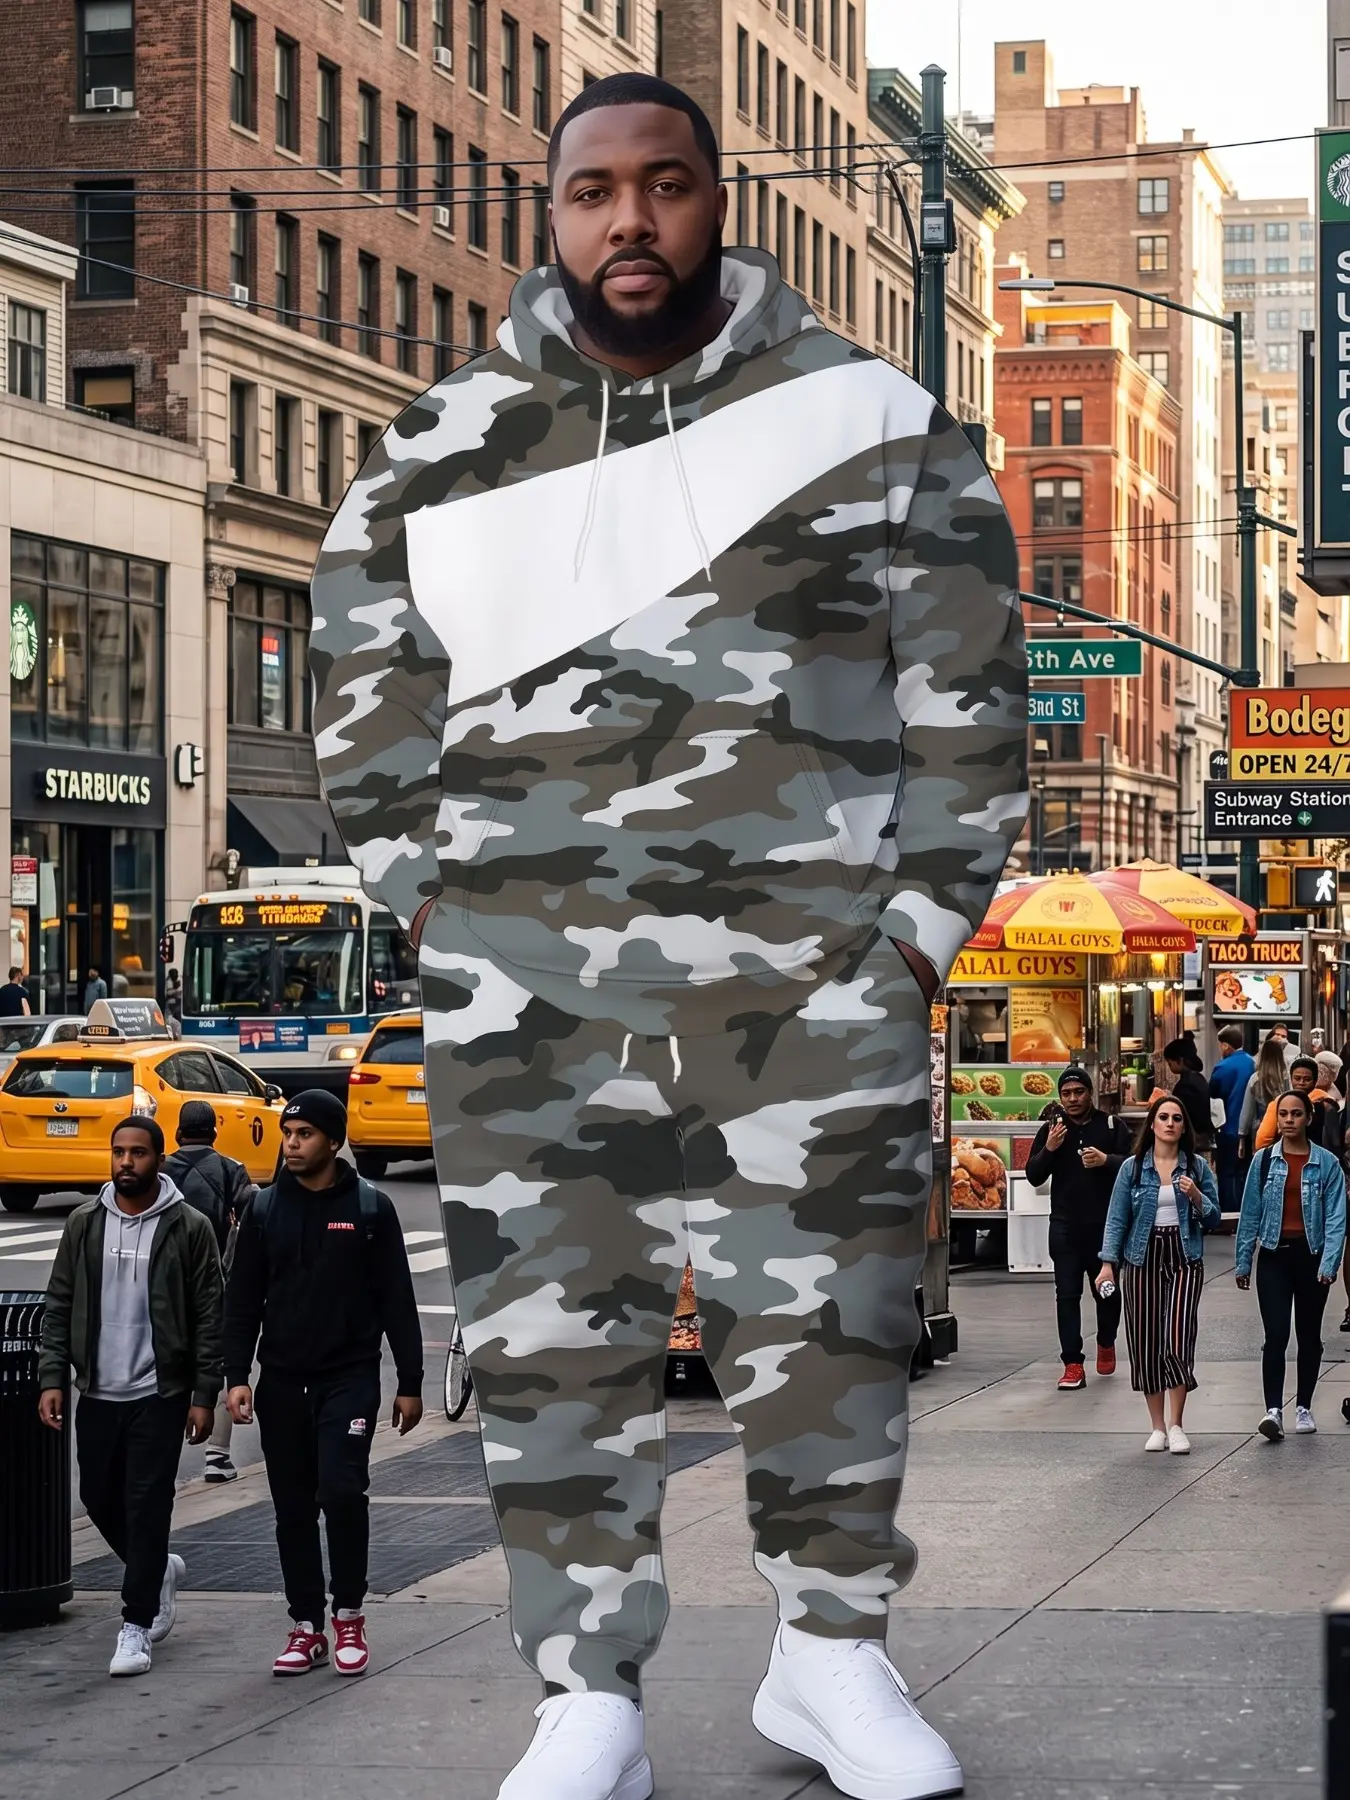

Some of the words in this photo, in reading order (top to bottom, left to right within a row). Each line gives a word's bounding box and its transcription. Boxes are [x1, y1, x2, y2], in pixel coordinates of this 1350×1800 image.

[1069, 649, 1116, 669] Ave
[1061, 697, 1080, 717] St
[1248, 694, 1350, 744] Bodeg
[1239, 754, 1297, 774] OPEN
[45, 768, 151, 806] STARBUCKS
[1214, 791, 1283, 810] Subway
[1289, 791, 1350, 806] Station
[1214, 811, 1293, 826] Entrance
[1015, 931, 1066, 946] HALAL
[1132, 935, 1160, 947] HALAL
[1209, 943, 1248, 961] TACO
[1251, 943, 1301, 961] TRUCK
